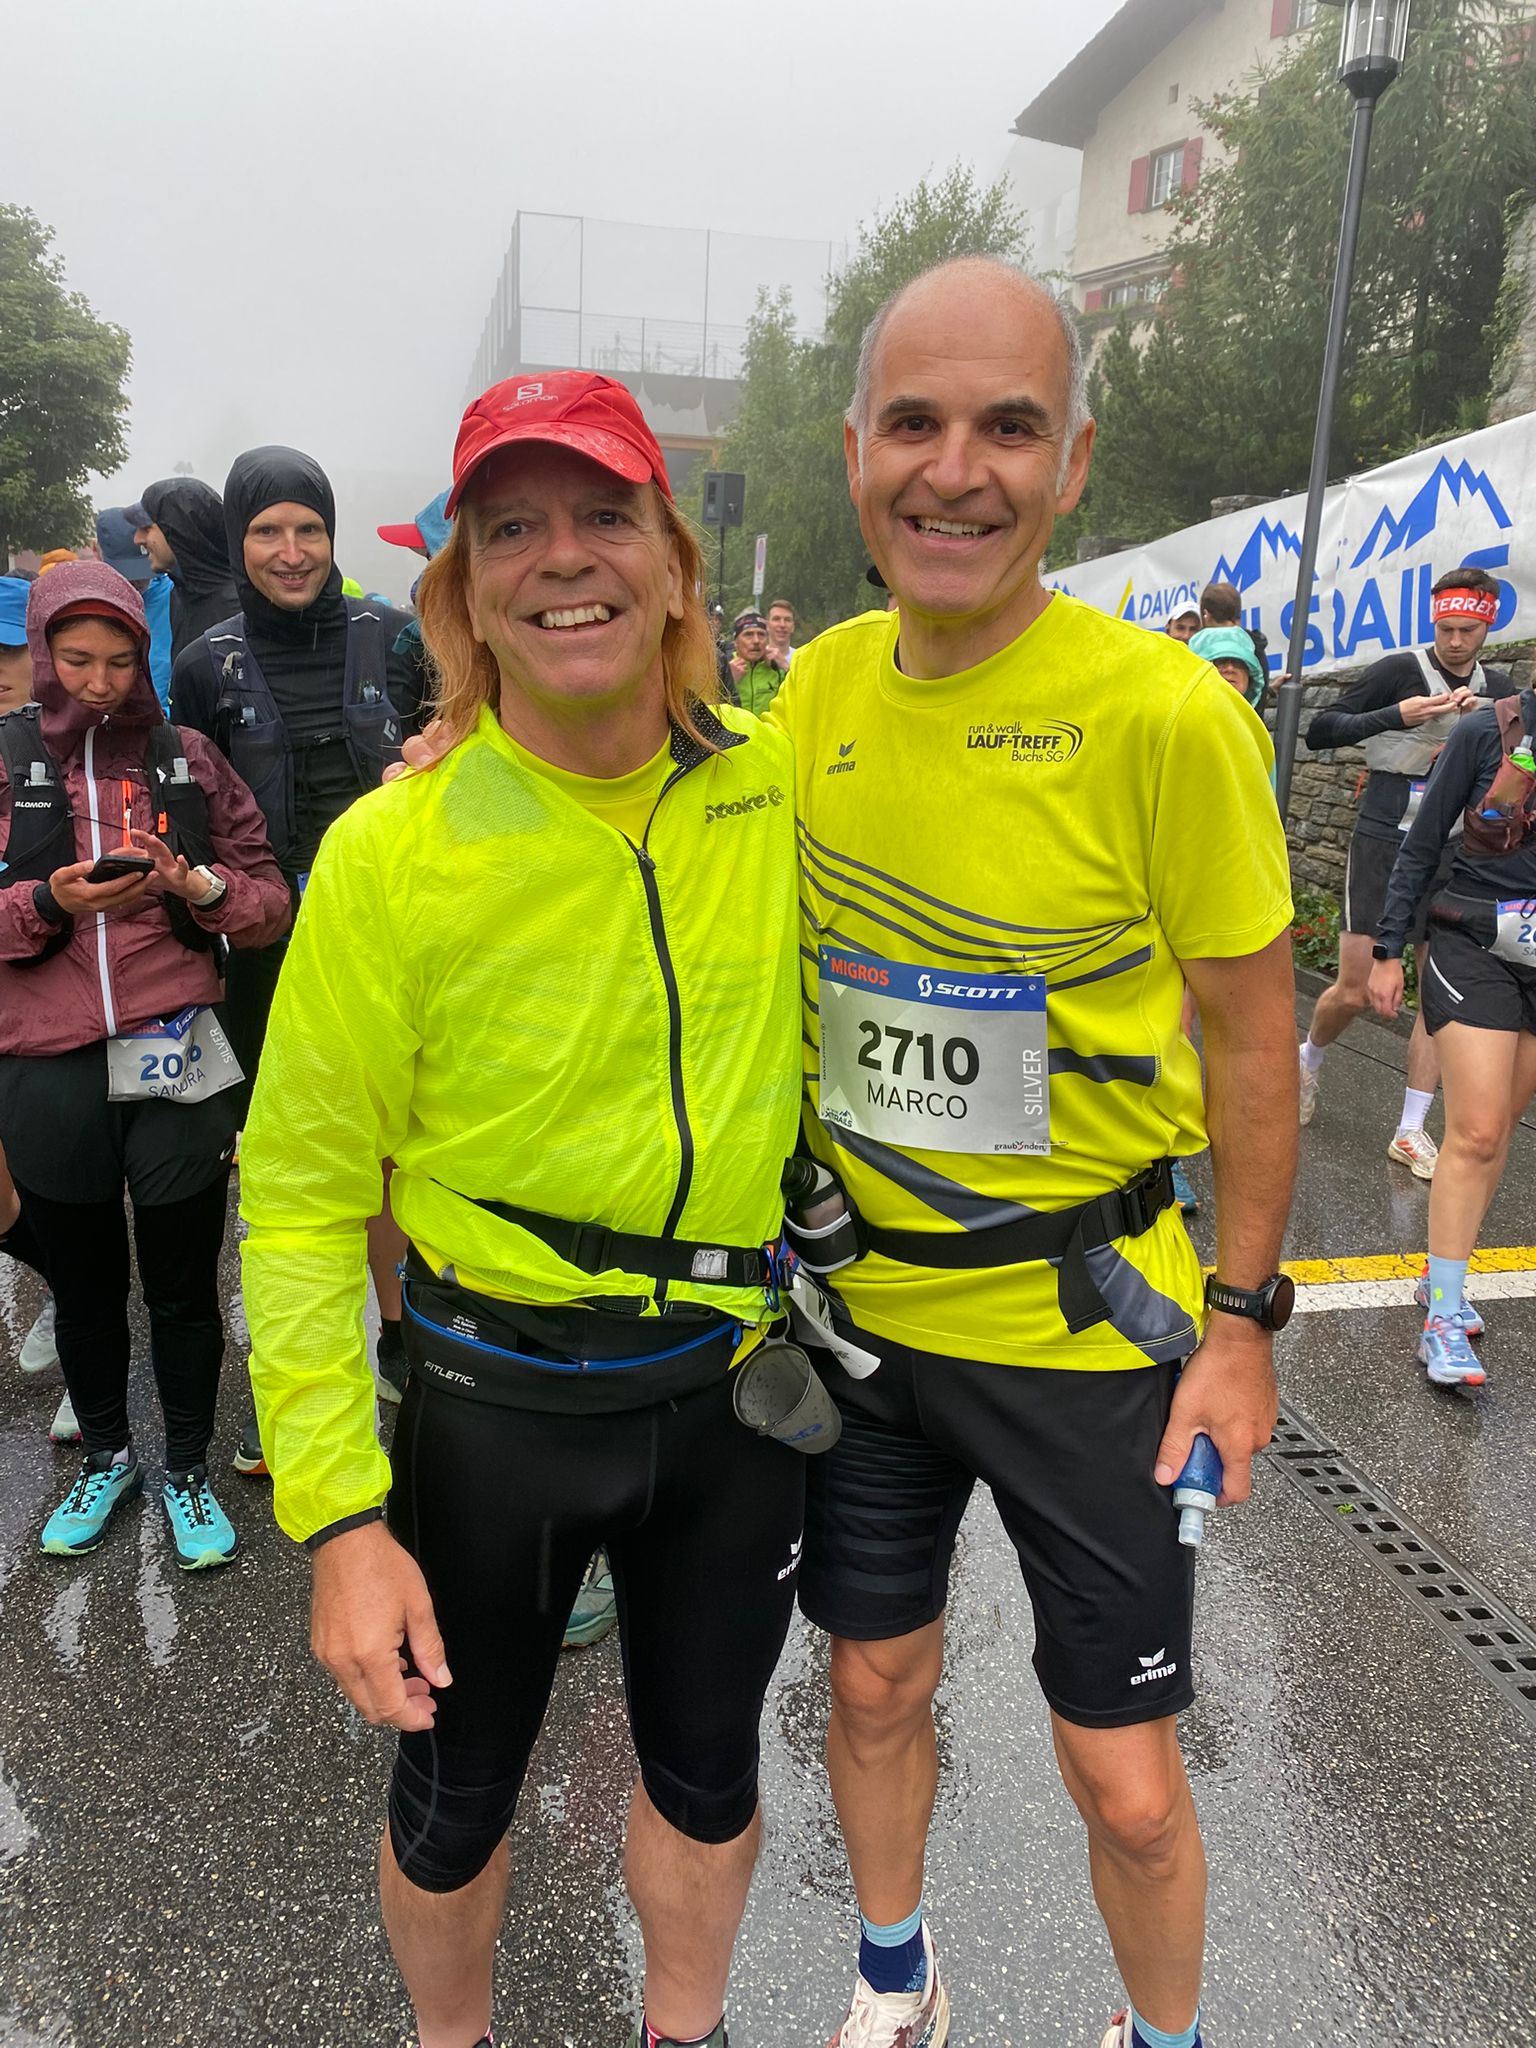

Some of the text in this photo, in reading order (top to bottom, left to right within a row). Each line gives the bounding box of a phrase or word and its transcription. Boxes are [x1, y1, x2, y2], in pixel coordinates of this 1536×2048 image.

[1435, 596, 1493, 617] TERREX
[968, 721, 1023, 735] run & walk
[966, 734, 1062, 750] LAUF-TREFF
[826, 760, 856, 775] erima
[1011, 750, 1065, 763] Buchs SG
[831, 957, 890, 987] MIGROS
[934, 983, 1022, 999] SCOTT
[209, 1027, 233, 1064] SILVER
[858, 1019, 980, 1086] 2710
[1022, 1049, 1043, 1116] SILVER
[868, 1079, 968, 1120] MARCO
[1130, 1662, 1177, 1686] erima
